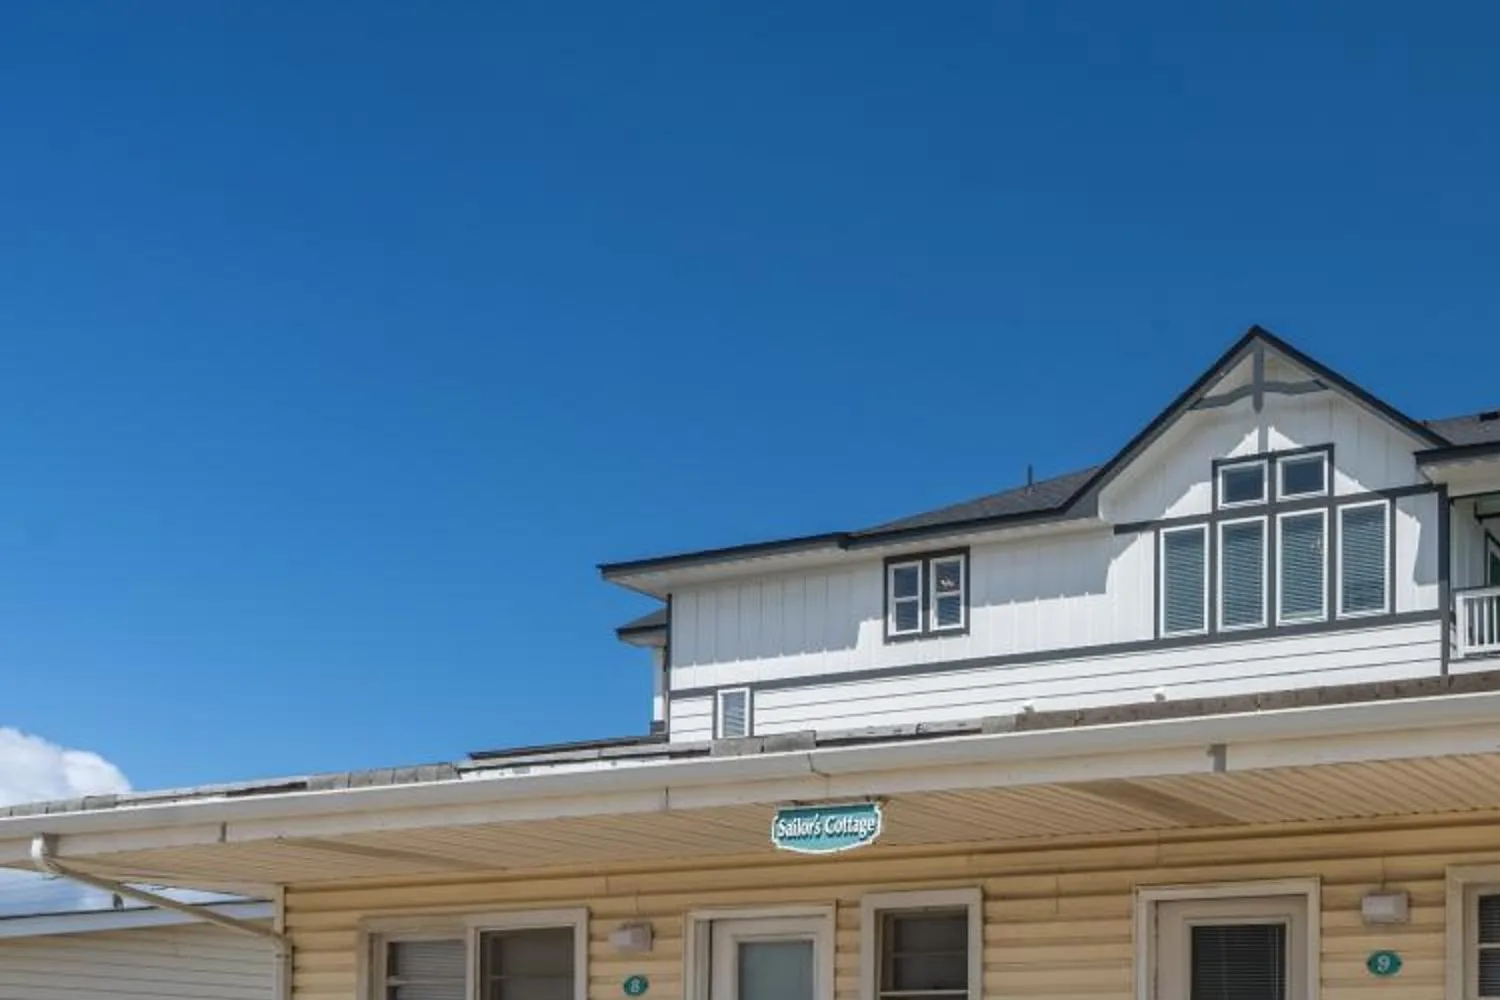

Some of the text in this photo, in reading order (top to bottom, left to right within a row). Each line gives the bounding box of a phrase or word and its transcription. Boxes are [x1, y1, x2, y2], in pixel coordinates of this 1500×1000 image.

[778, 813, 875, 839] Sailor's Cottage
[1377, 955, 1391, 973] 9
